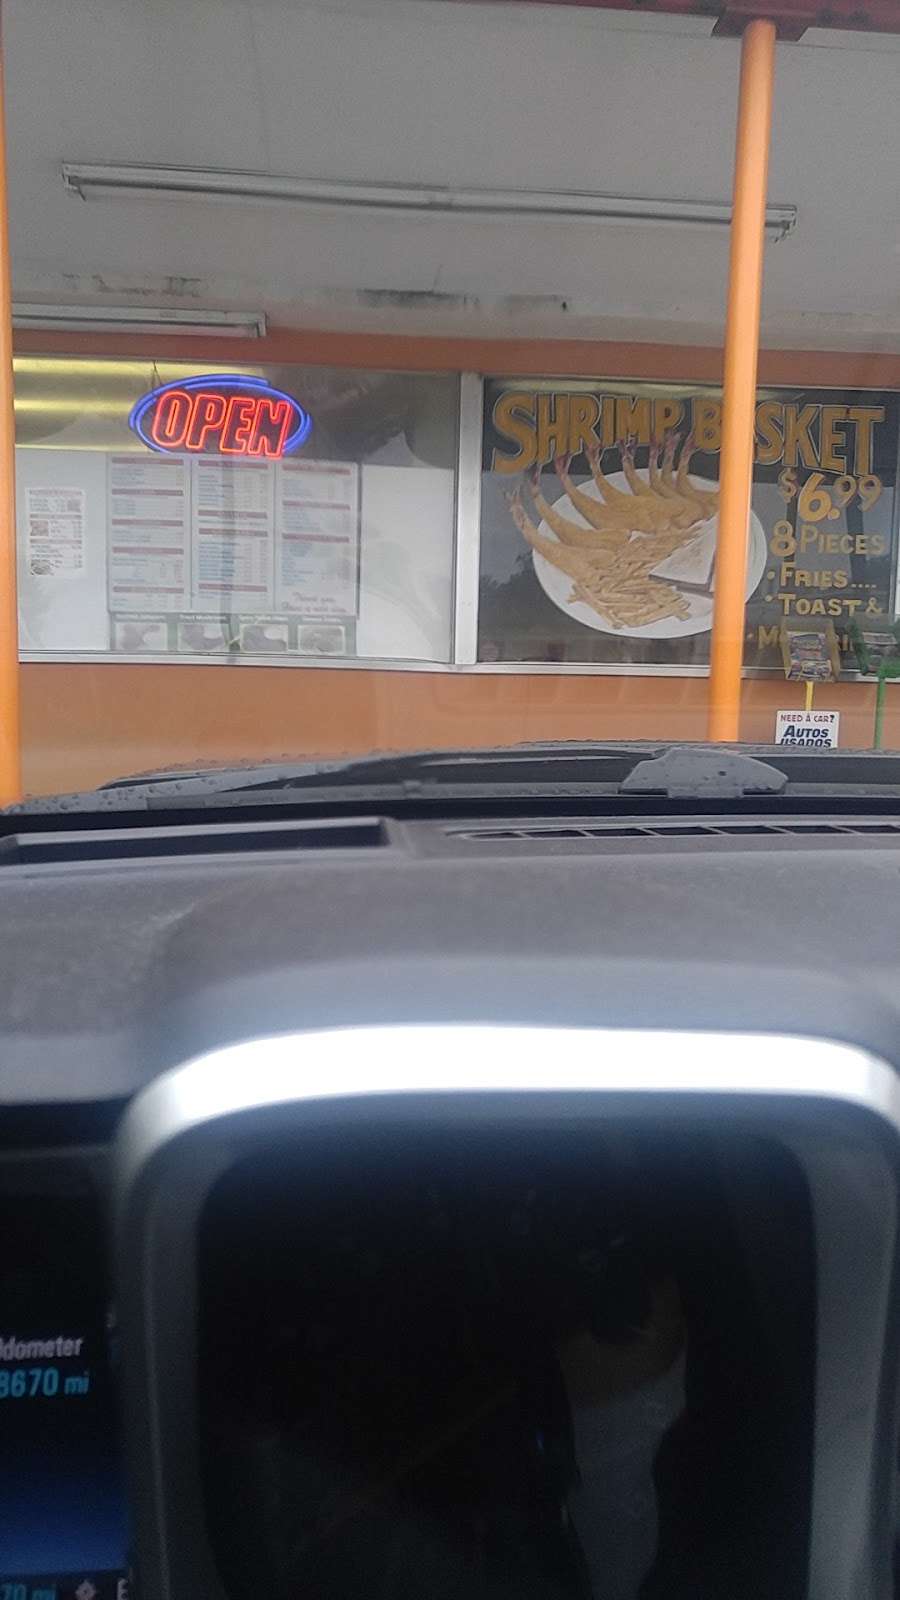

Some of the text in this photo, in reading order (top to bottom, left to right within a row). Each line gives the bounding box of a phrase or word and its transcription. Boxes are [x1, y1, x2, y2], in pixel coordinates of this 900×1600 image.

[152, 390, 292, 457] OPEN
[491, 392, 886, 477] SHRIMP BSKET
[769, 520, 885, 557] 8 PIECES
[777, 593, 883, 617] TOAST &
[780, 714, 835, 723] NEED A CAR?
[783, 725, 829, 738] AUTOS
[0, 1336, 83, 1360] dometer
[64, 1370, 90, 1395] mi
